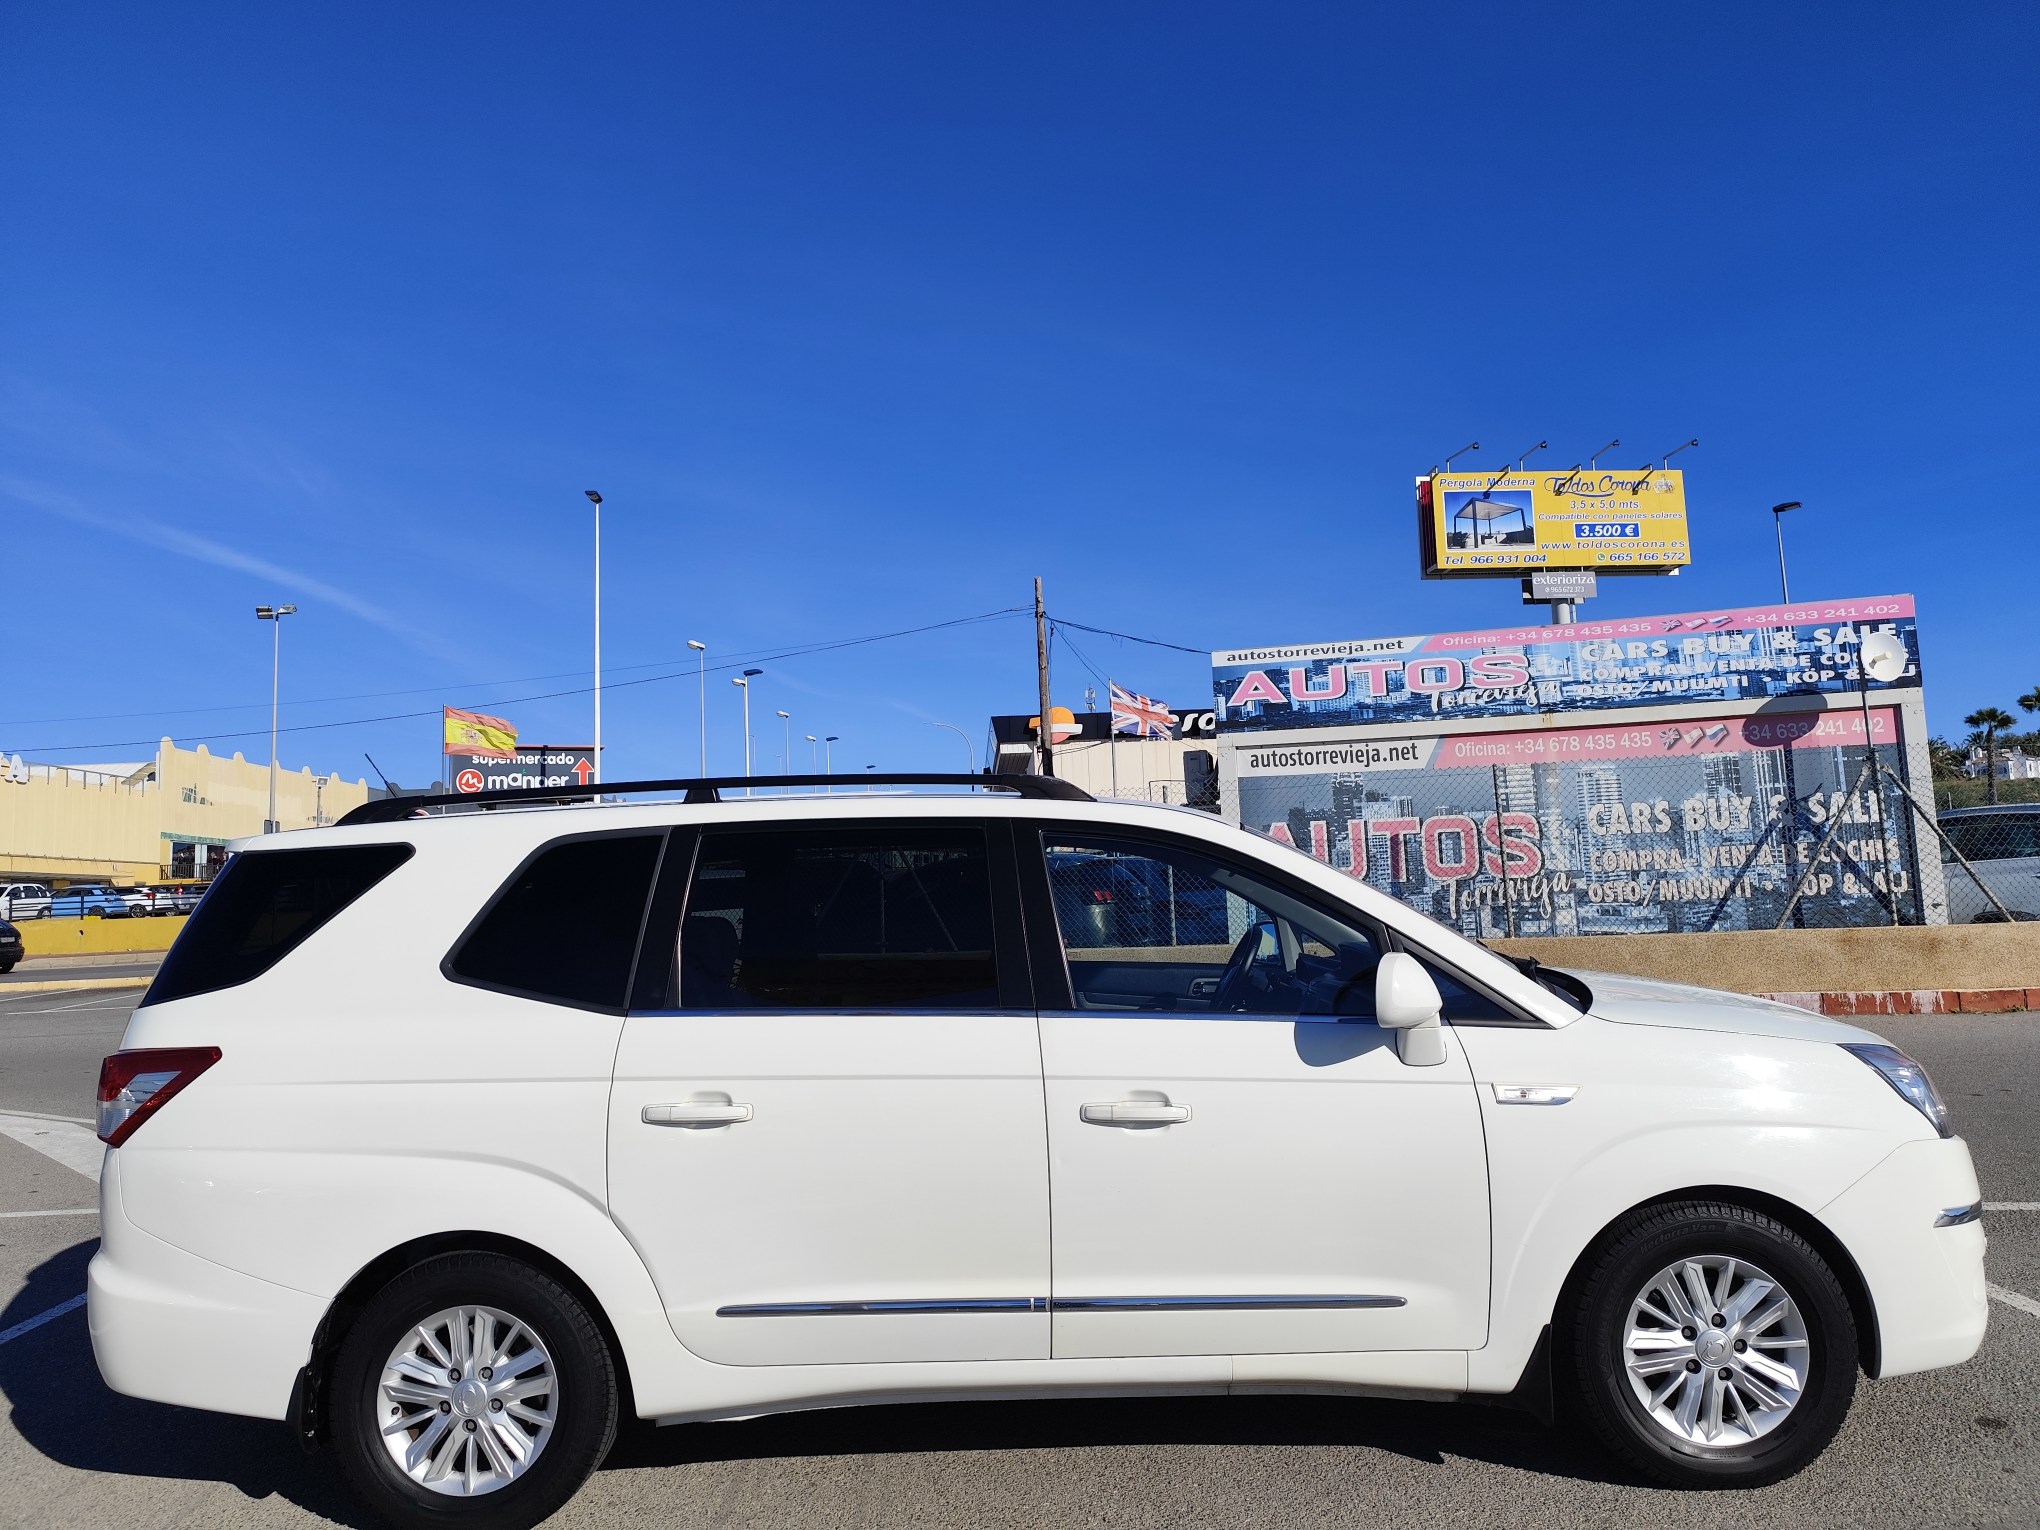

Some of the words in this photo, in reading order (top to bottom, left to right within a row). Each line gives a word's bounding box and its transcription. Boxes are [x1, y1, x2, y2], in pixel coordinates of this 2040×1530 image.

[1486, 477, 1536, 487] Moderna
[1538, 513, 1590, 521] Compatible
[1612, 512, 1648, 521] paneles
[1650, 511, 1683, 519] solares
[1580, 525, 1622, 537] 3.500
[1624, 524, 1636, 537] €
[1540, 540, 1686, 550] www.toldoscorona.es
[1609, 553, 1633, 562] 665
[1637, 553, 1659, 561] 166
[1663, 552, 1686, 561] 572
[1445, 556, 1466, 565] Tel.
[1470, 555, 1494, 564] 966
[1497, 554, 1519, 564] 931
[1523, 554, 1547, 563] 004
[1533, 574, 1595, 585] exterioriza
[1442, 634, 1502, 647] Oficina:
[1505, 630, 1538, 642] +34
[1542, 628, 1576, 640] 678
[1582, 624, 1614, 636] 435
[1617, 622, 1651, 635] 435
[1743, 612, 1779, 624] +34
[1783, 609, 1820, 622] 633
[1823, 607, 1857, 619] 241
[1863, 604, 1900, 616] 402
[1226, 639, 1405, 663] autostorrevieja.net
[1581, 639, 1670, 661] CARS
[1682, 632, 1758, 656] BUY
[1771, 631, 1800, 649] &
[1227, 653, 1532, 707] AUTOS
[1581, 662, 1679, 682] COMPRA
[1697, 656, 1773, 673] VENTA
[1781, 654, 1812, 668] DE
[1786, 668, 1836, 684] KÖP
[1430, 681, 1561, 713] Torrevieja
[1455, 741, 1511, 758] Oficina:
[1514, 739, 1545, 754] +34
[1550, 736, 1580, 751] 678
[1584, 734, 1616, 750] 435
[1620, 731, 1652, 748] 435
[1739, 724, 1772, 740] +34
[1776, 722, 1810, 739] 633
[1815, 719, 1847, 736] 241
[1851, 716, 1885, 733] 402
[1250, 742, 1419, 768] autostorrevieja.net
[1588, 800, 1673, 836] CARS
[1683, 796, 1752, 832] BUY
[1590, 848, 1684, 872] COMPRA
[1703, 842, 1775, 867] VENTA
[1780, 842, 1810, 864] DE
[1447, 868, 1573, 920] Torrevieja
